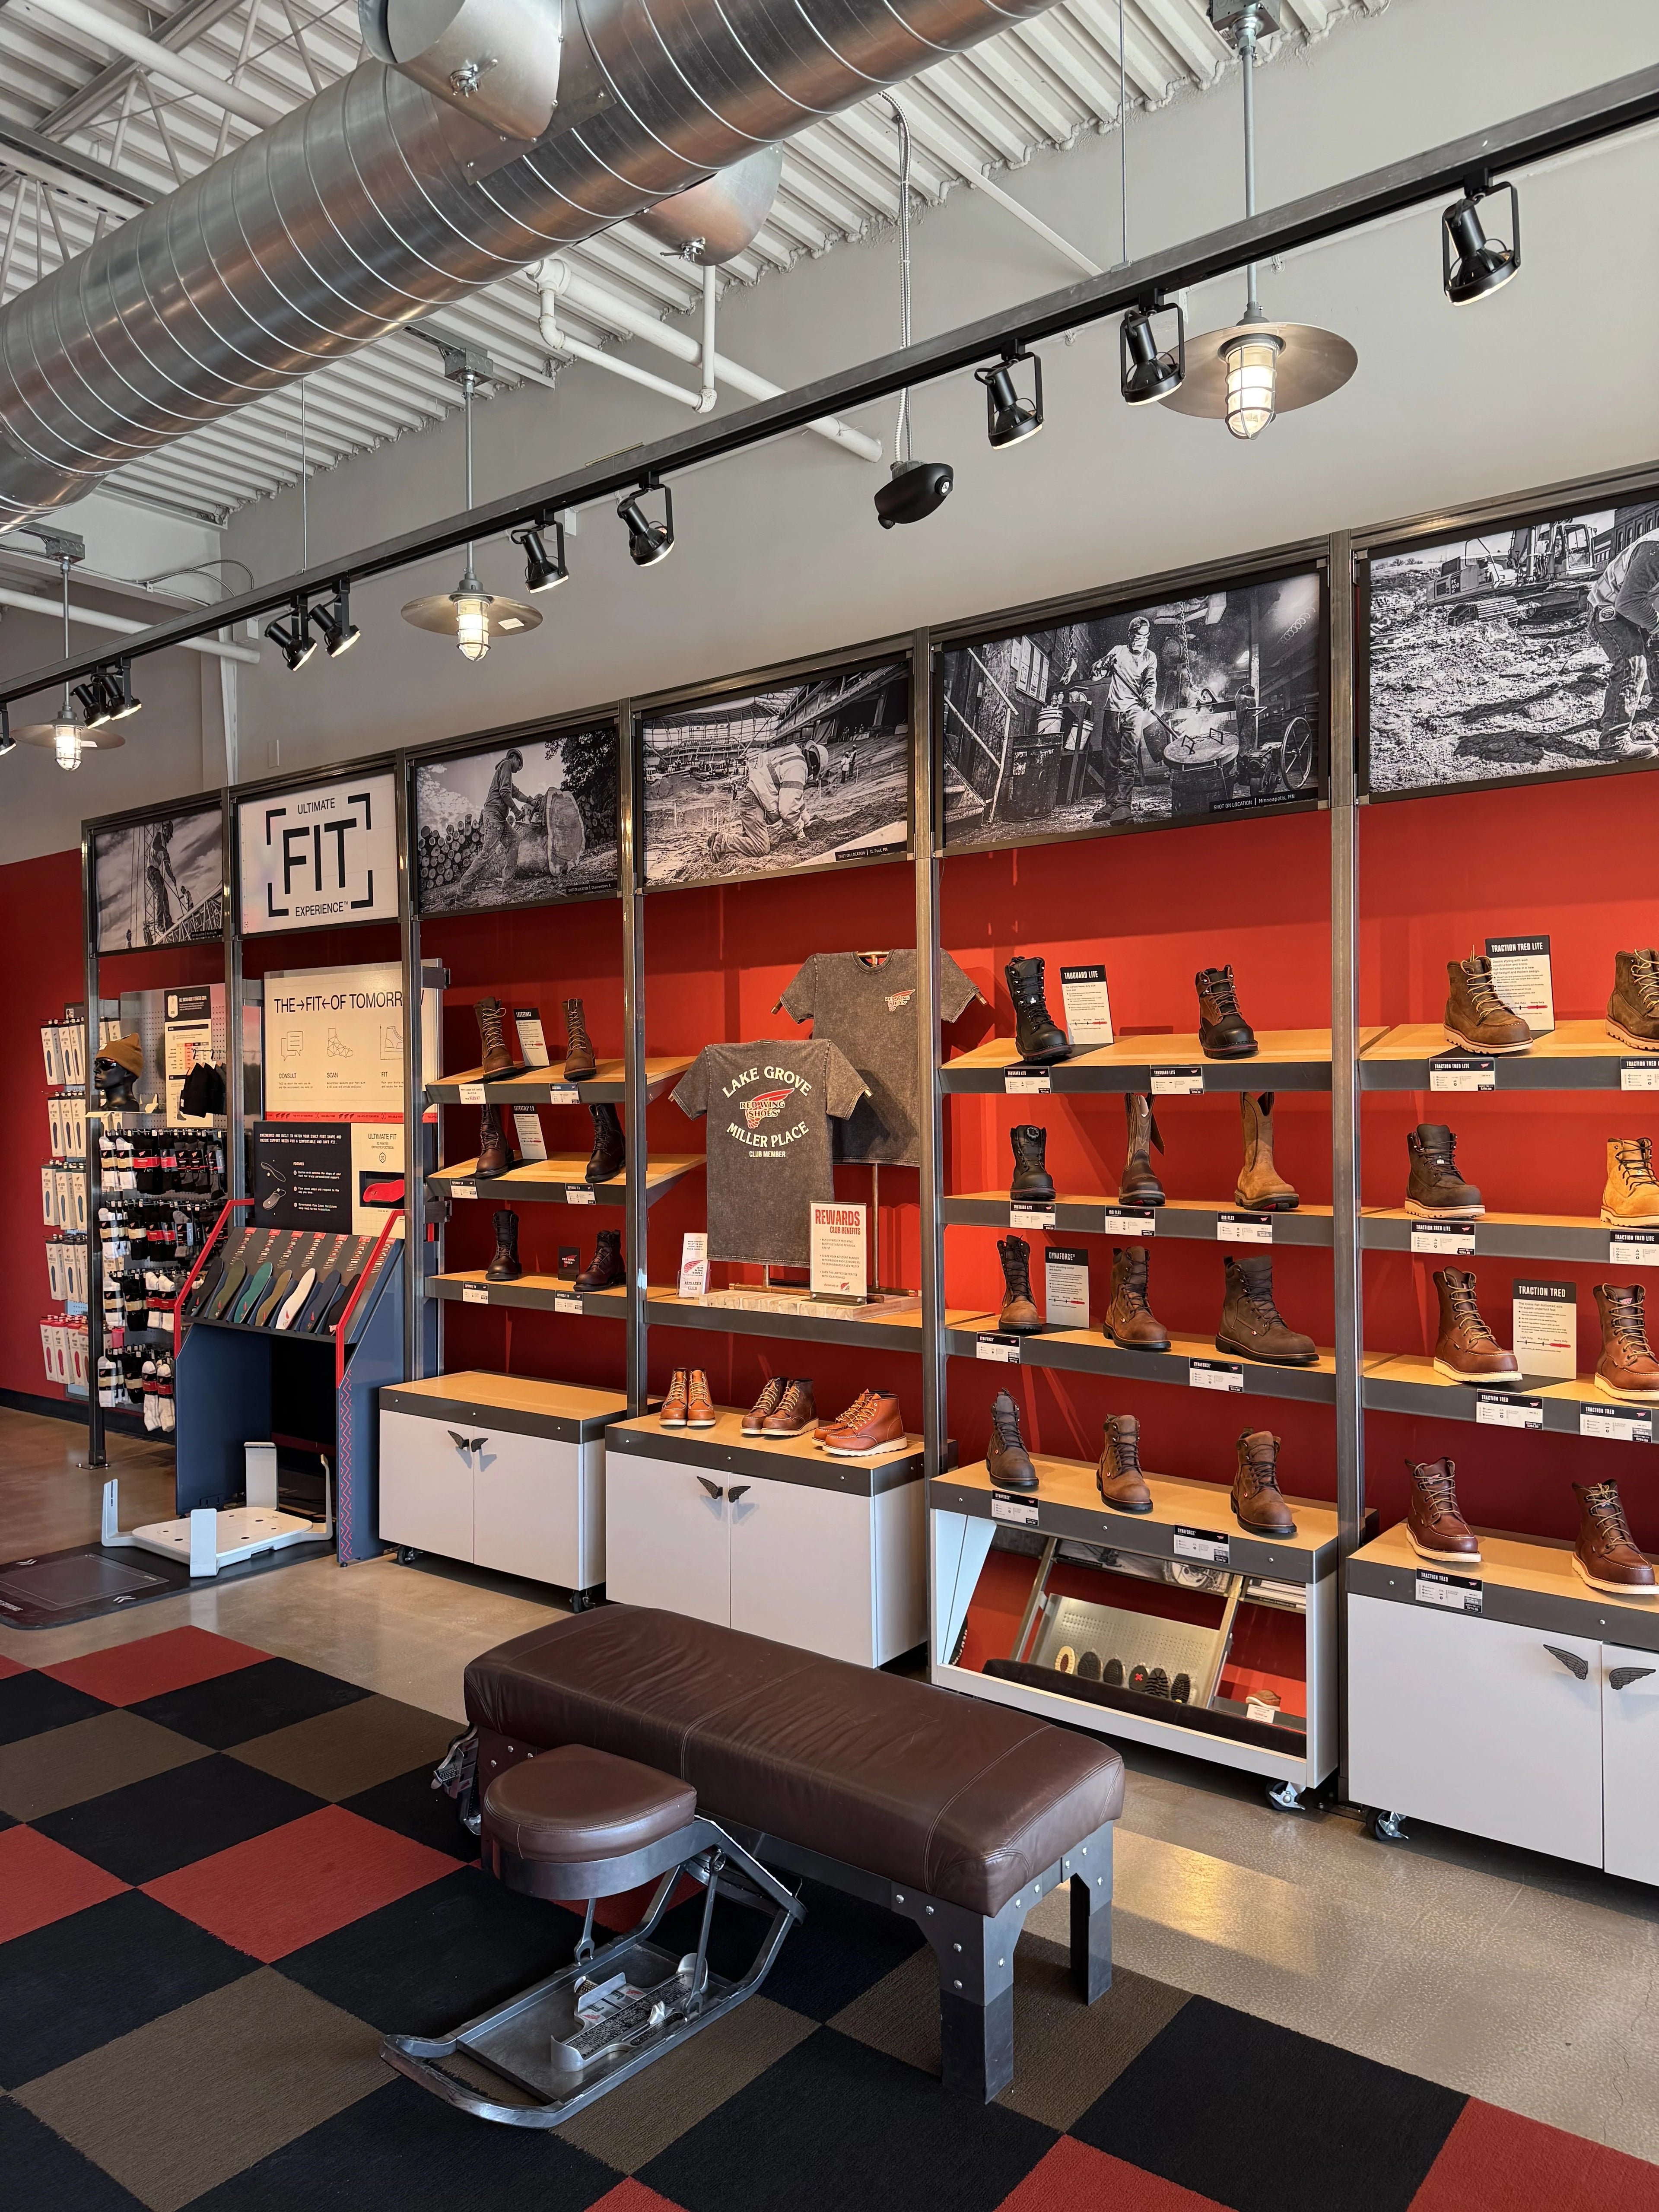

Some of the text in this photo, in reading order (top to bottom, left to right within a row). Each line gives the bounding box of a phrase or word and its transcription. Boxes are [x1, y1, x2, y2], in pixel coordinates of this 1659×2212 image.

[298, 798, 335, 814] ULTIMATE
[283, 818, 357, 894] FIT
[1491, 944, 1516, 953] TRACTION
[274, 995, 346, 1013] THE FIT OF
[722, 1066, 812, 1098] LAKE GROVE
[726, 1121, 809, 1147] MILLER PLACE
[815, 1209, 860, 1226] REWARDS
[1519, 1286, 1566, 1297] TRACTION TRED
